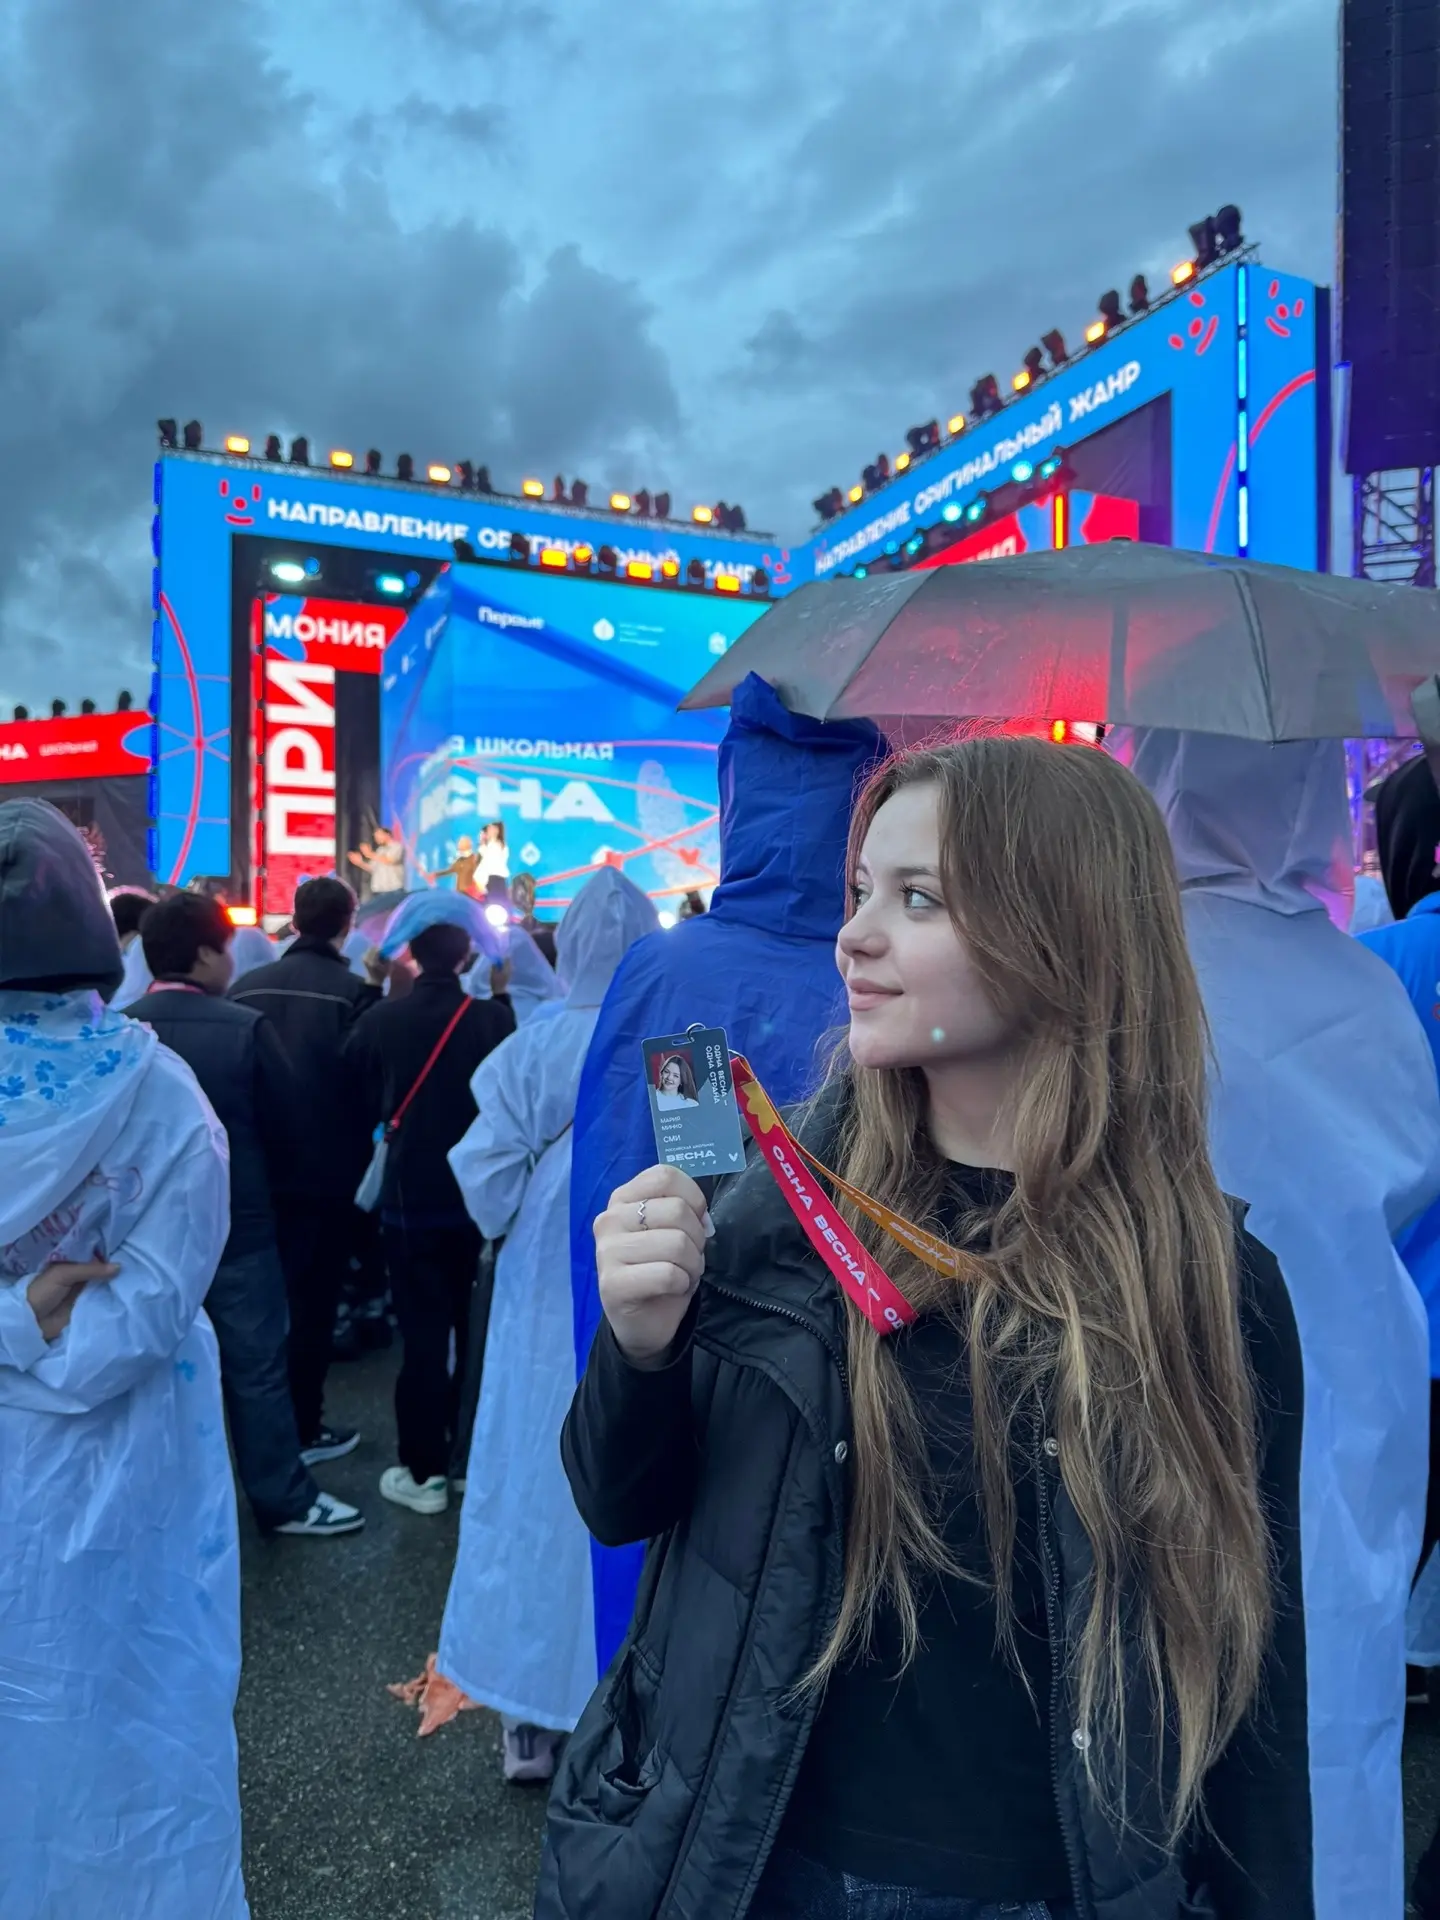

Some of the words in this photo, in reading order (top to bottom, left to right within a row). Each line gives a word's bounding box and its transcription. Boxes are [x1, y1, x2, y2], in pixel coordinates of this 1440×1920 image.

[814, 501, 912, 577] НАПРАВЛЕНИЕ
[914, 402, 1062, 515] ОРИГИНАЛЬНЫЙ
[1068, 360, 1141, 423] ЖАНР
[267, 498, 469, 542] НАПРАВЛЕНИЕ
[265, 612, 385, 651] МОНИЯ
[266, 659, 336, 857] ПРИ
[475, 736, 615, 762] ШКОЛЬНАЯ
[705, 1045, 715, 1069] ОДНА
[713, 1044, 723, 1068] ОДНА
[709, 1071, 720, 1104] СТРАНА
[717, 1070, 728, 1098] ВЕСНА
[663, 1134, 681, 1143] СМИ
[666, 1149, 716, 1162] ВЕСНА
[772, 1145, 813, 1211] ОДНА
[813, 1214, 866, 1286] ВЕСНА
